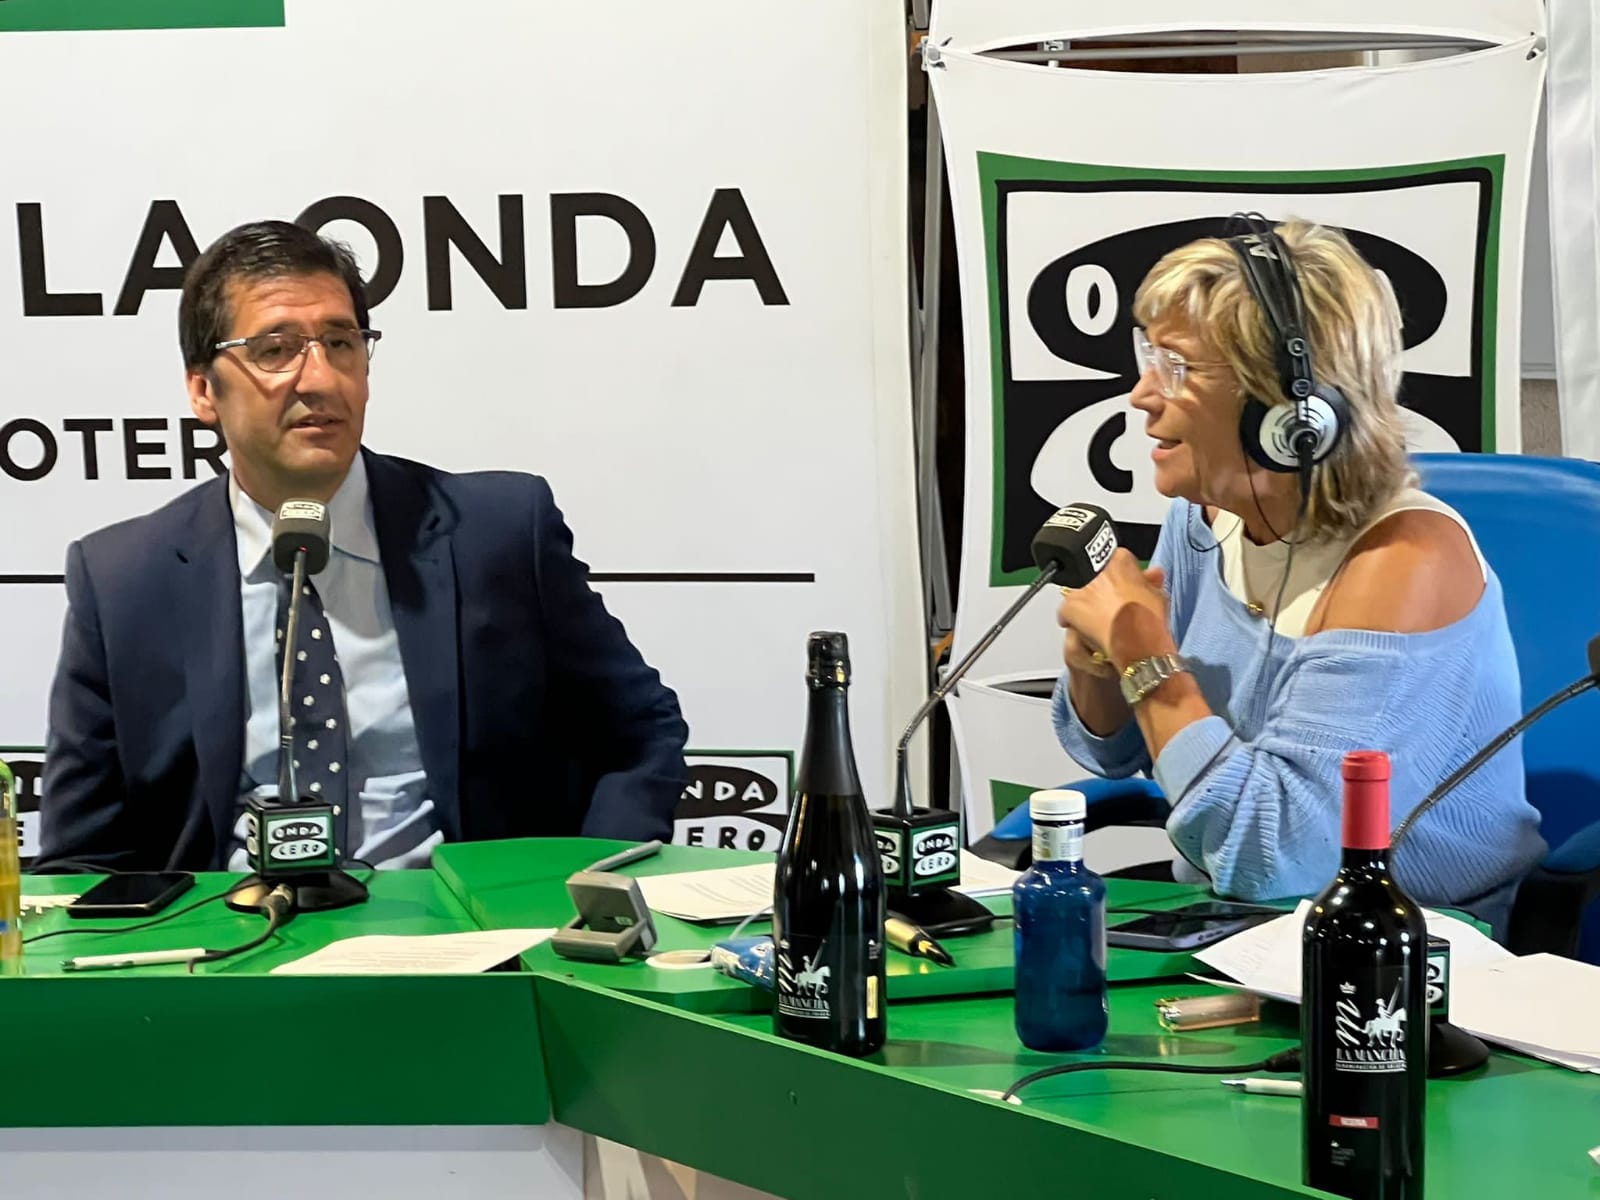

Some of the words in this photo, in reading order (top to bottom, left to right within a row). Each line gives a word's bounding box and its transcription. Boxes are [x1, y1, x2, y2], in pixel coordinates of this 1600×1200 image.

[15, 199, 203, 317] LA
[0, 417, 228, 481] OTER
[680, 780, 765, 802] NDA
[275, 826, 320, 839] ONDA
[687, 826, 766, 852] ERO
[278, 843, 319, 856] CERO
[918, 837, 951, 853] ONDA
[920, 857, 950, 871] CERO
